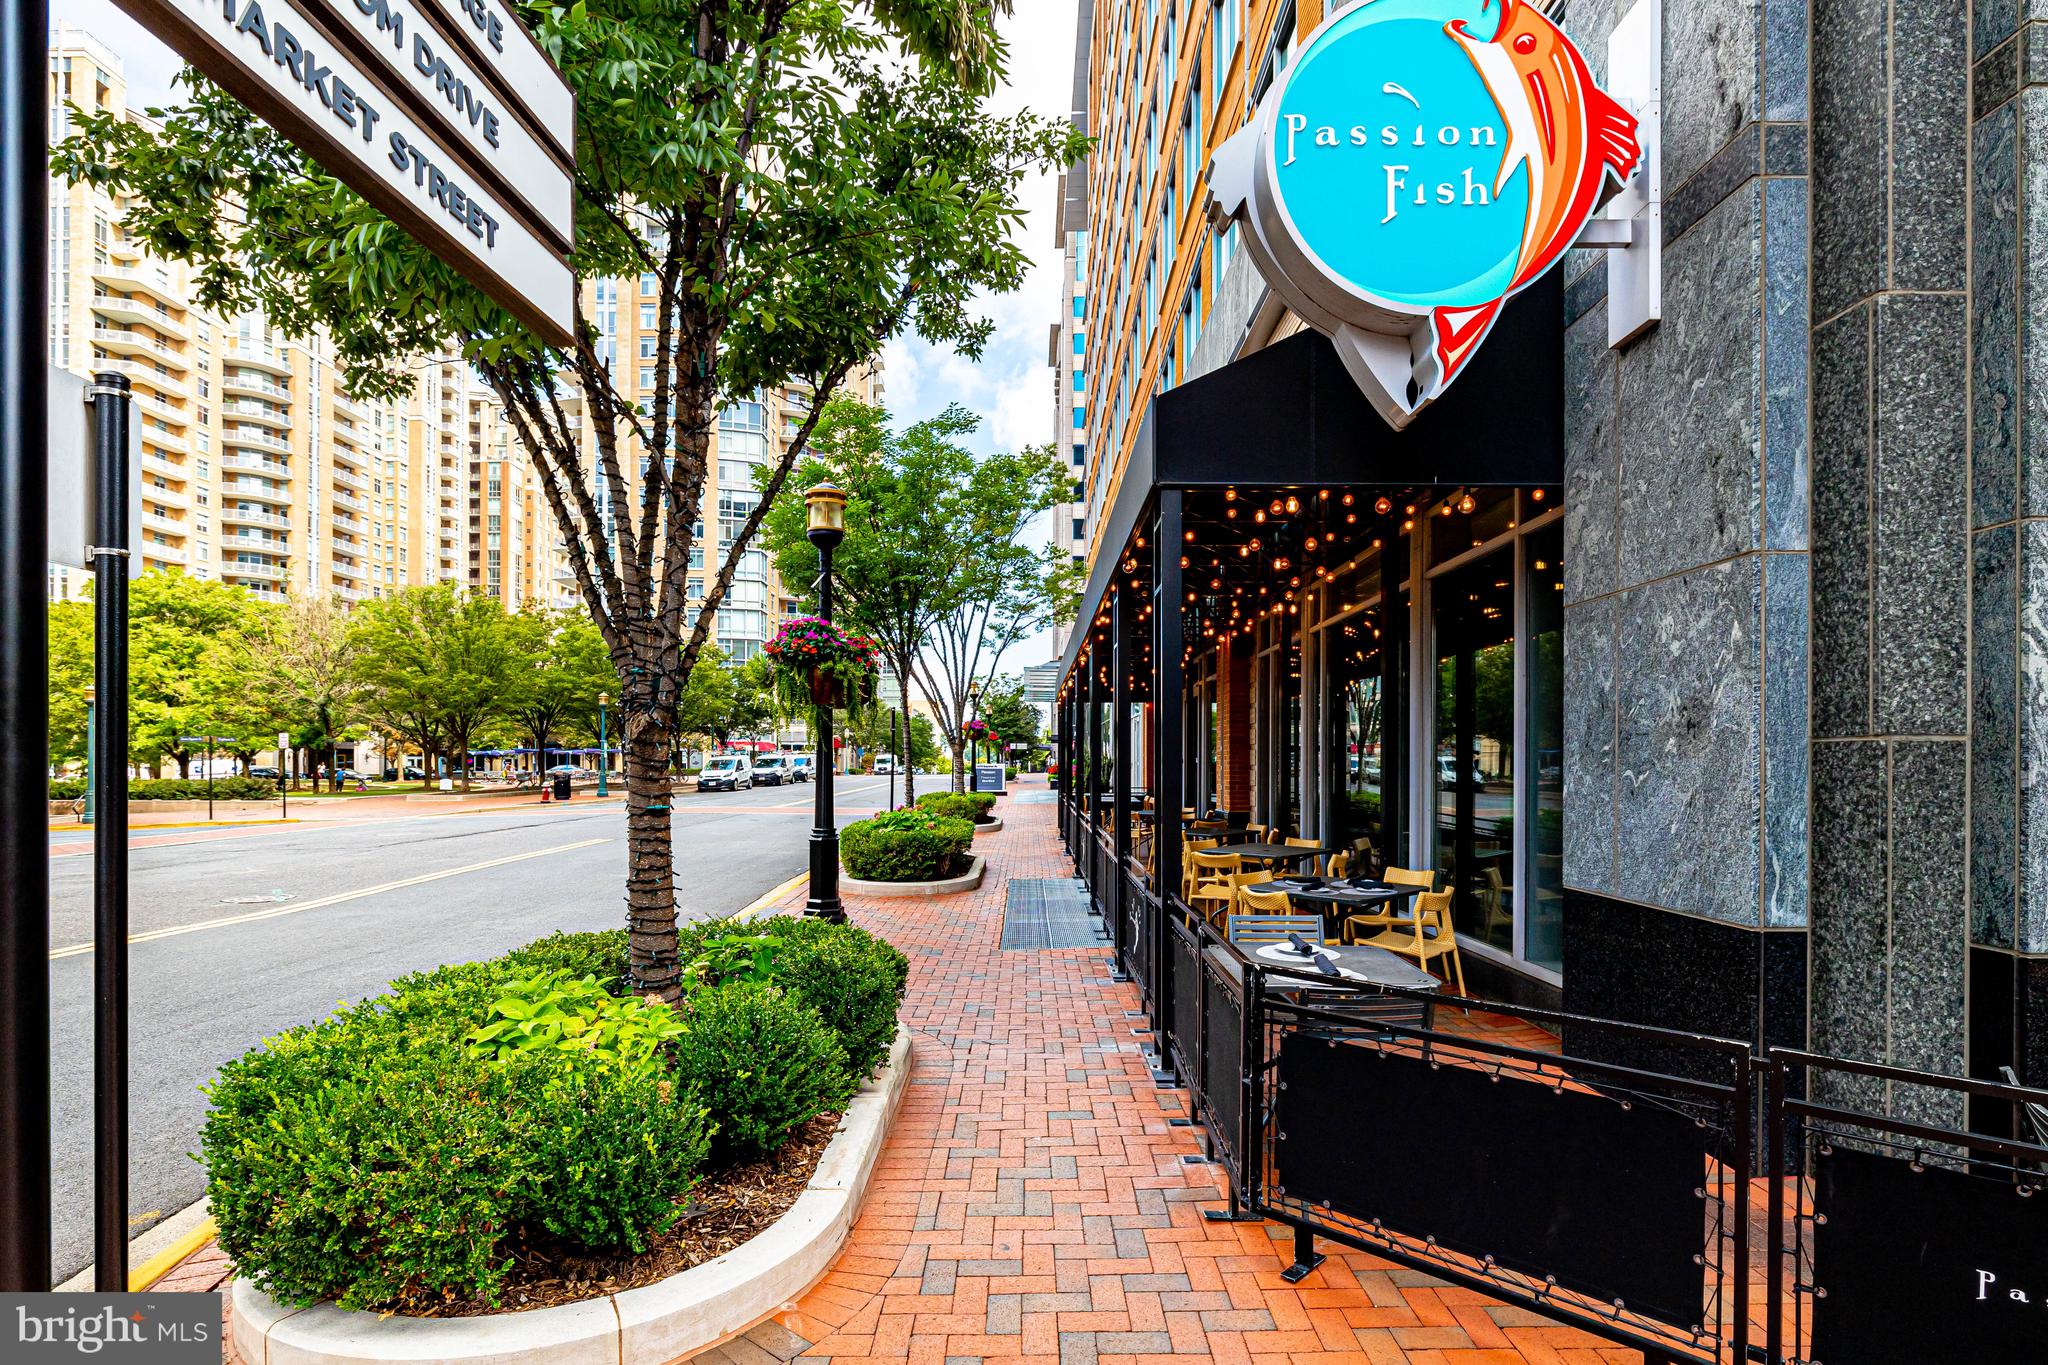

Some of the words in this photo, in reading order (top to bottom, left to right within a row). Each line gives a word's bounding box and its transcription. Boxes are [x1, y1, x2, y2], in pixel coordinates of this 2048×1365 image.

[460, 0, 504, 53] GE
[413, 32, 500, 149] DRIVE
[1282, 84, 1497, 166] Passion
[388, 131, 500, 248] STREET
[1380, 164, 1490, 224] Fish
[1975, 1268, 2048, 1308] Pa
